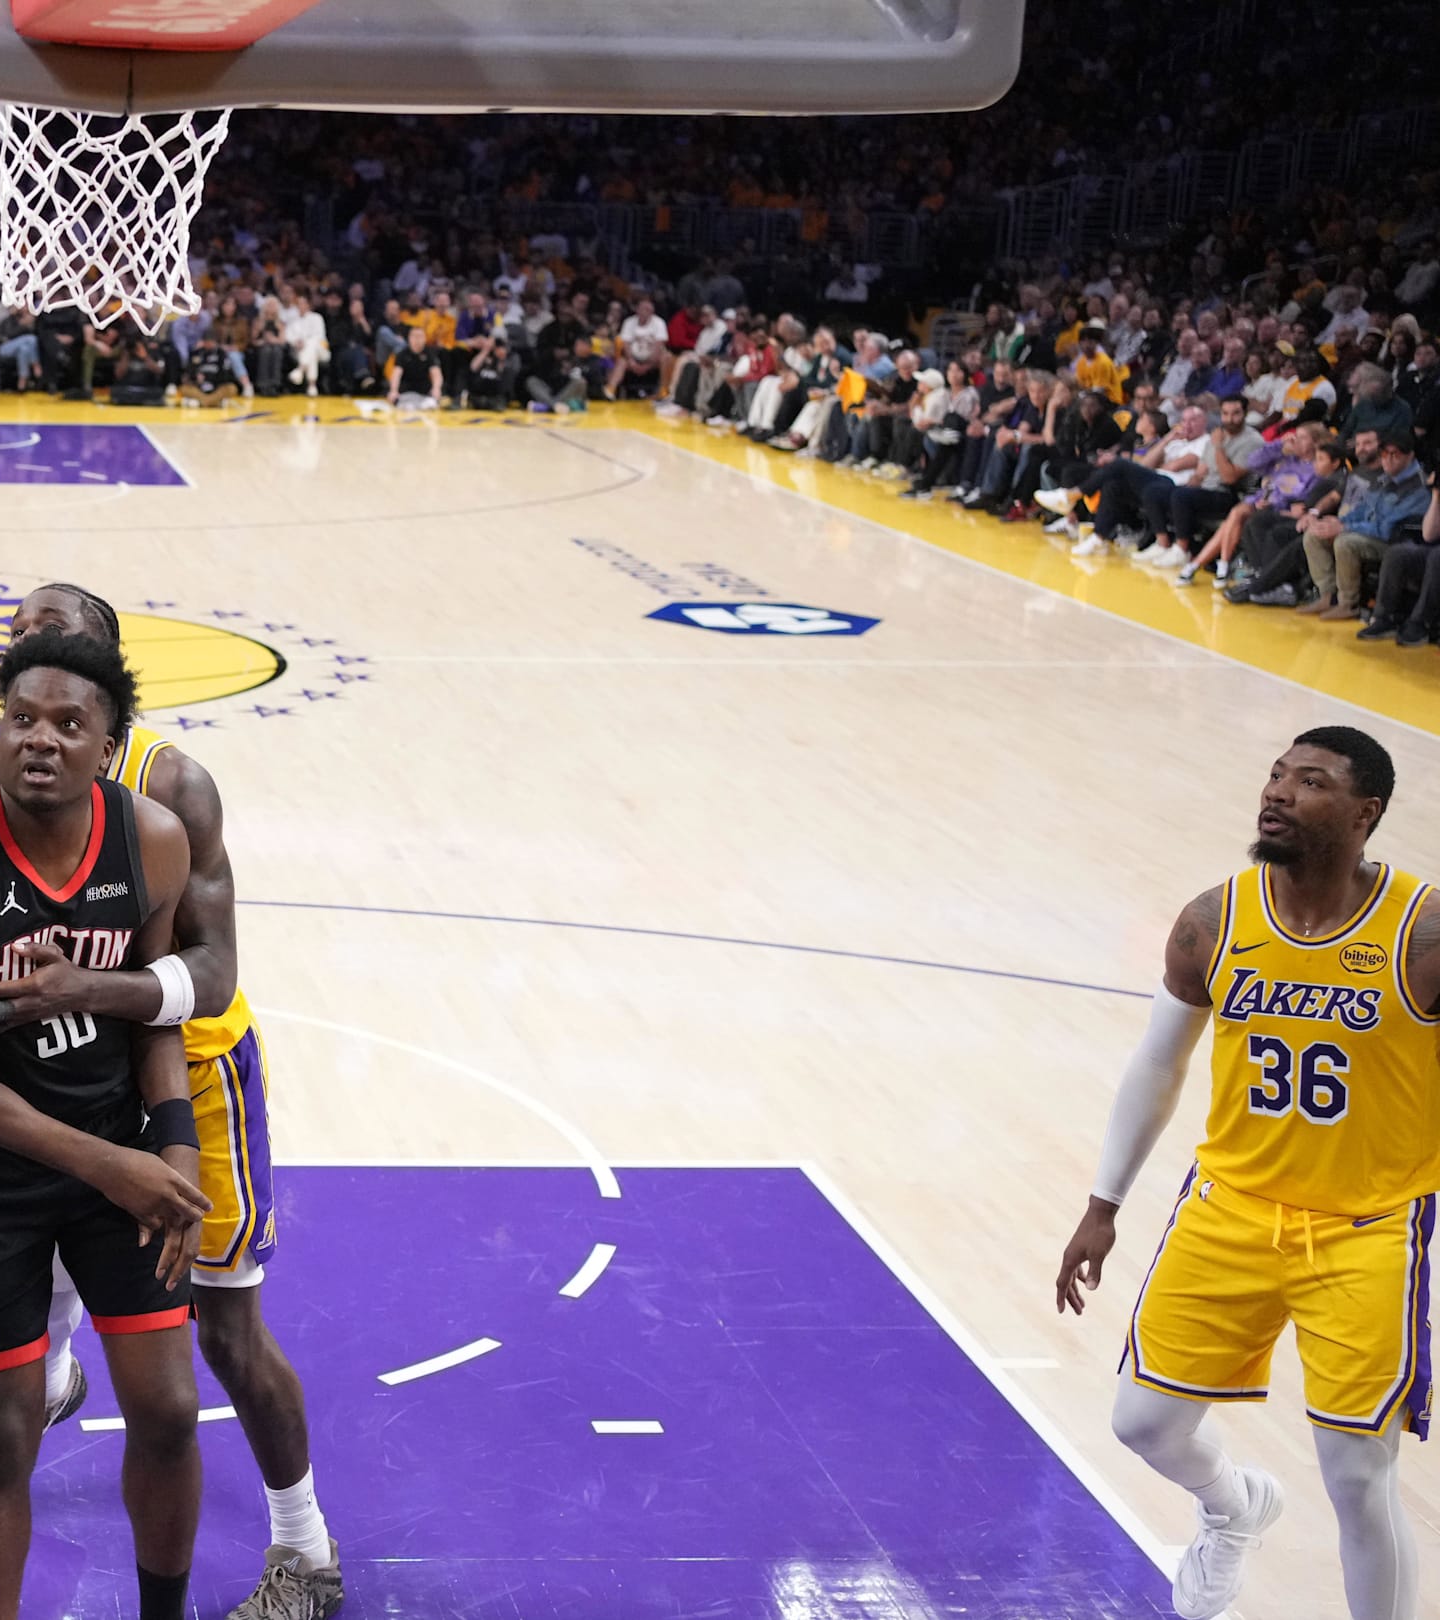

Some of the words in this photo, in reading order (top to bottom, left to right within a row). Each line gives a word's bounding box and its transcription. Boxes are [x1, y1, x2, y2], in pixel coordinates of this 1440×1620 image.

[1344, 950, 1385, 966] bibigo
[1218, 966, 1385, 1034] LAKERS
[1247, 1033, 1351, 1127] 36
